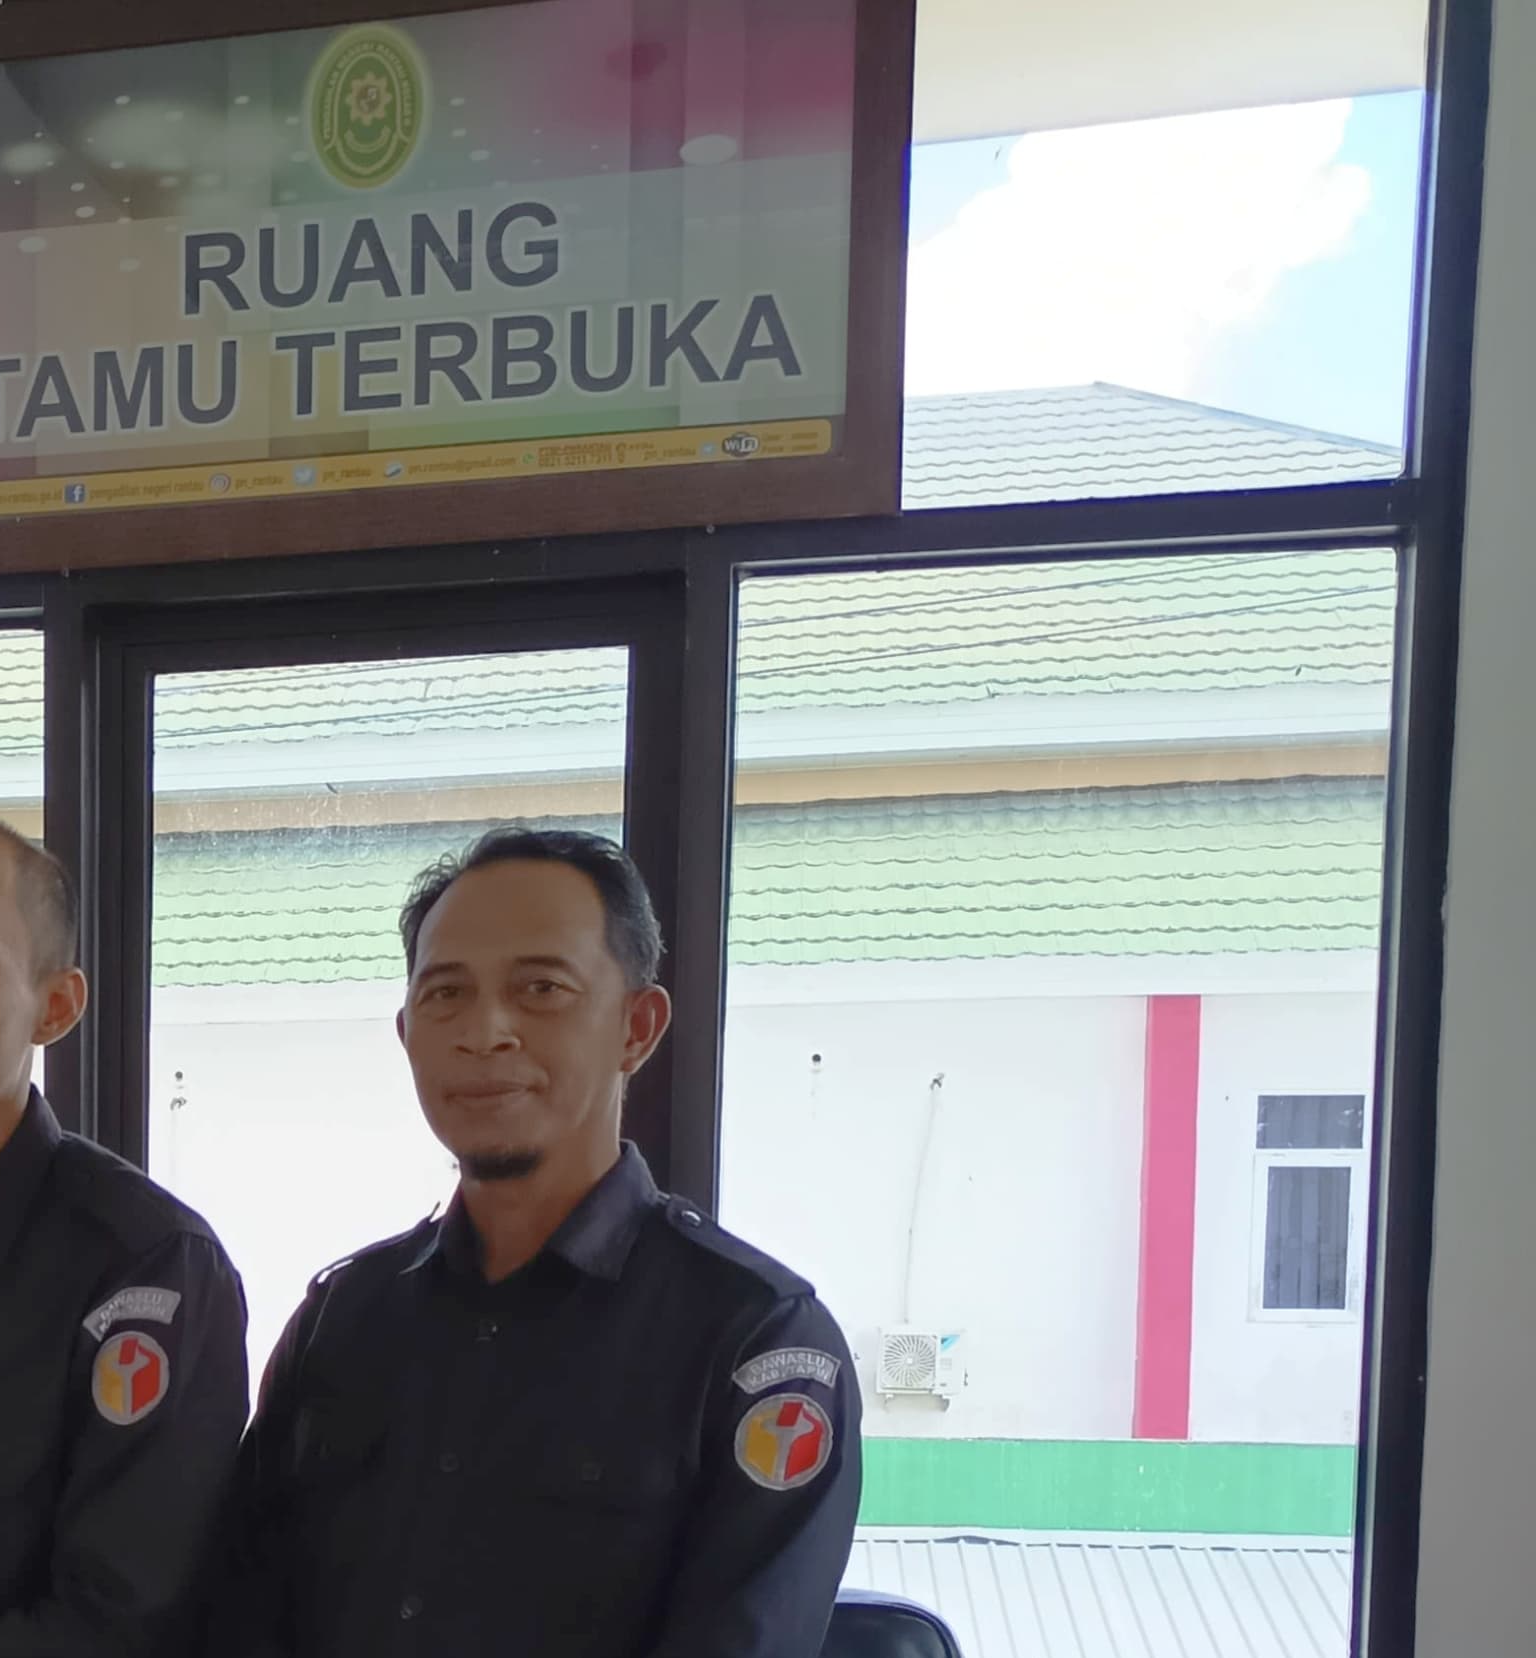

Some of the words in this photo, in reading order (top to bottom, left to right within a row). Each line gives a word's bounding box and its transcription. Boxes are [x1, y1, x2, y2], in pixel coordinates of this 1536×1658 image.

[183, 200, 562, 316] RUANG
[275, 293, 803, 417] TERBUKA
[749, 1352, 827, 1378] BAWASLU
